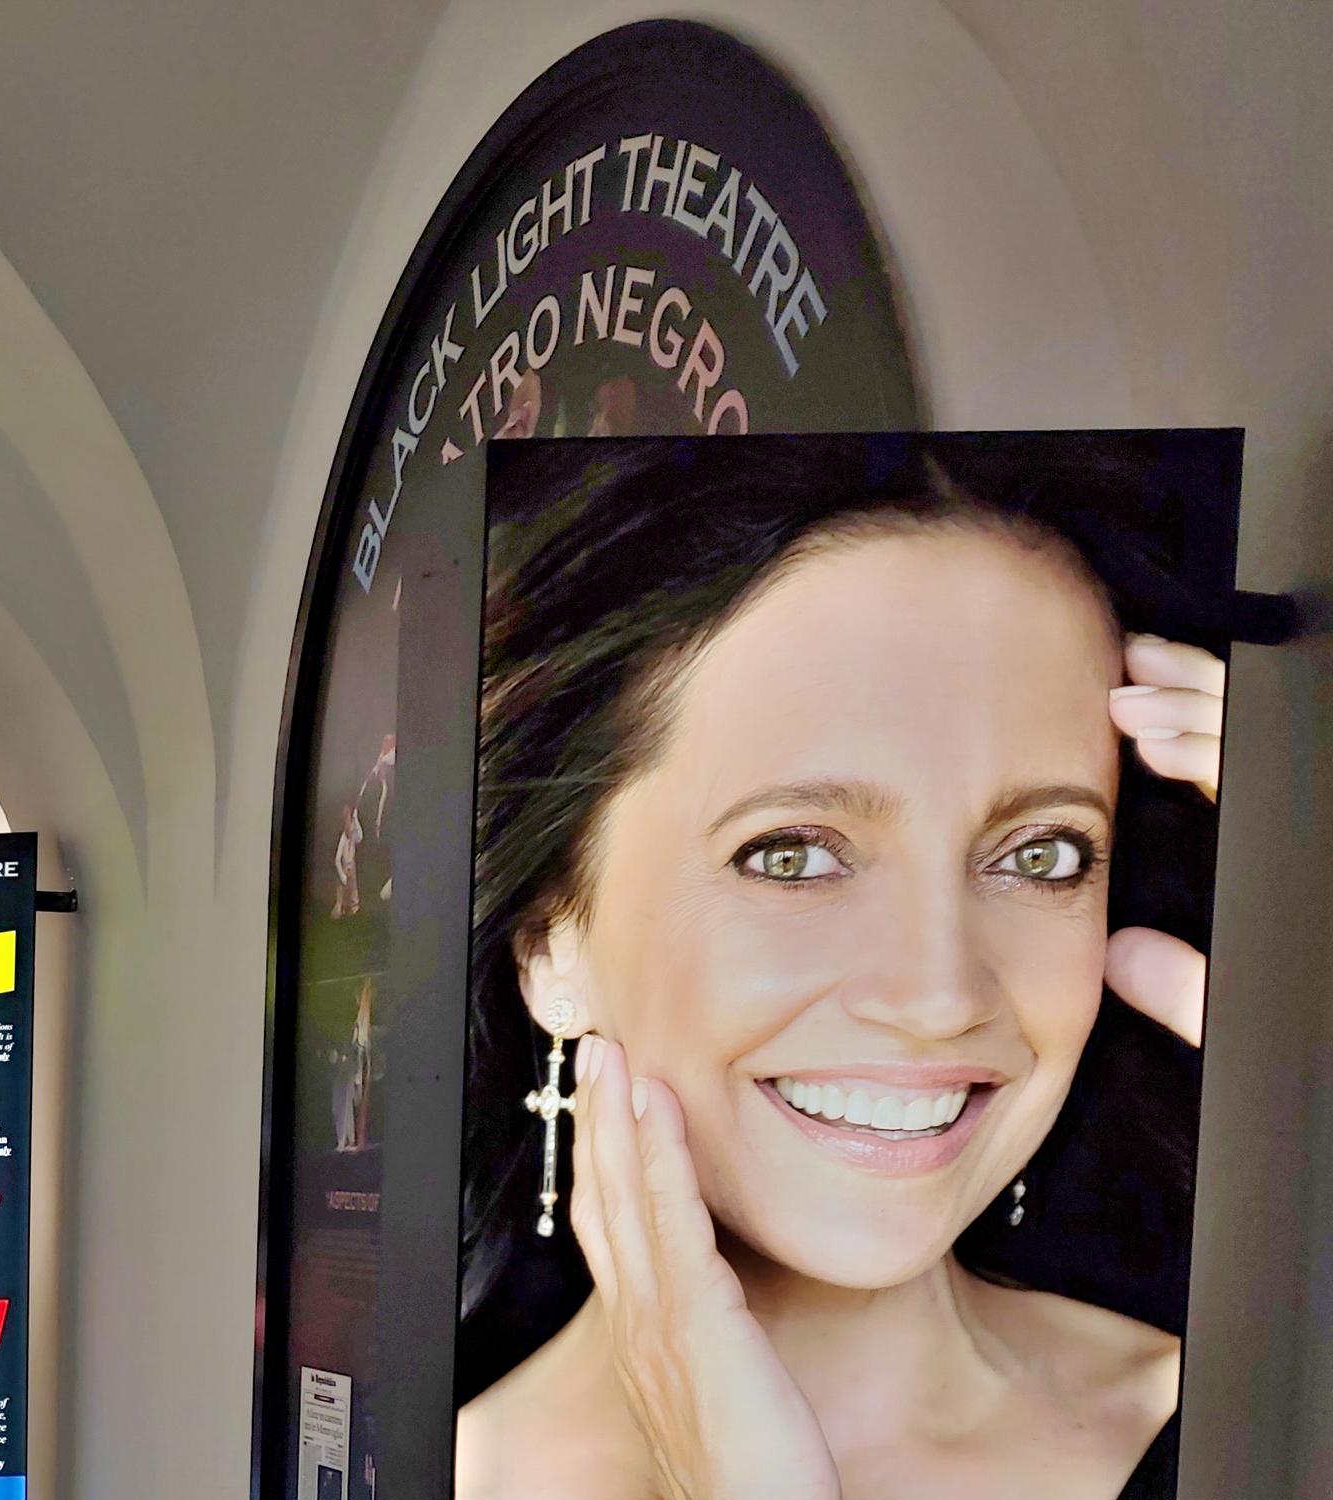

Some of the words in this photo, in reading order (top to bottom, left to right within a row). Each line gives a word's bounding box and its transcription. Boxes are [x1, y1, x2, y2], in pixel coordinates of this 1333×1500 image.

[351, 302, 466, 594] BLACK
[471, 143, 607, 328] LIGHT
[618, 132, 829, 378] THEATRE
